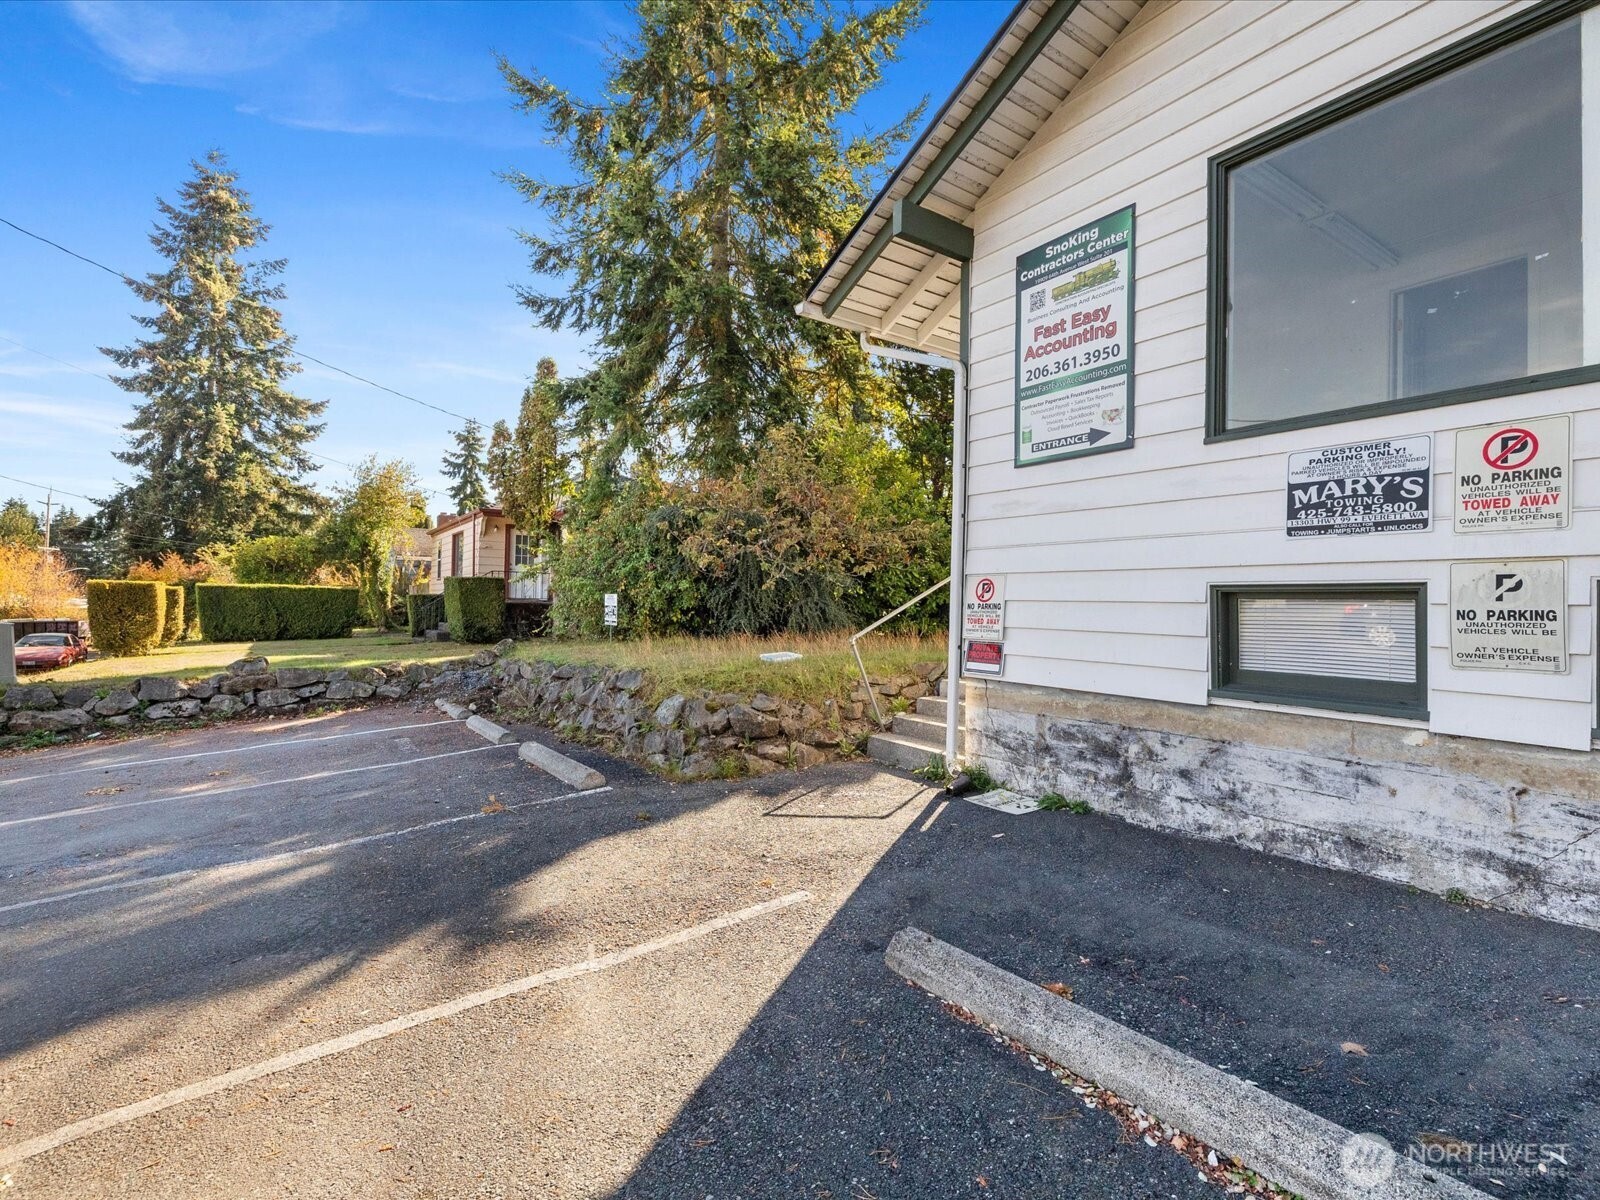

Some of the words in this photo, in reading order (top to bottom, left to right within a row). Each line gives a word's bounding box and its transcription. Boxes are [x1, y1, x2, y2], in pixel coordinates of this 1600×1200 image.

[1045, 227, 1099, 258] SnoKing
[1020, 248, 1085, 282] Contractors
[1087, 229, 1129, 253] Center
[1027, 313, 1049, 325] Business
[1049, 302, 1078, 316] Consulting
[1079, 296, 1090, 305] And
[1091, 285, 1124, 300] Accounting
[1034, 318, 1067, 342] Fast
[1071, 304, 1112, 330] Easy
[1024, 321, 1117, 362] Accounting
[1025, 343, 1120, 382] 206.361.3950
[1020, 363, 1127, 397] www.FastEasyAccounting.com
[1021, 401, 1044, 411] Contractor
[1044, 395, 1070, 406] Paperwork
[1070, 387, 1100, 398] Frustrations
[1100, 381, 1125, 392] Removed
[1030, 406, 1054, 416] Outsourced
[1054, 402, 1070, 411] Payroll
[1074, 398, 1086, 406] Sales
[1095, 391, 1114, 401] Reports
[1041, 410, 1066, 420] Accounting
[1070, 402, 1101, 413] Bookkeeping
[1068, 411, 1095, 420] QuickBooks
[1074, 418, 1094, 428] Services
[1032, 433, 1089, 452] ENTRANCE
[1322, 441, 1392, 457] CUSTOMER
[1302, 460, 1354, 471] UNAUTHORIZED
[1366, 453, 1414, 463] IMPROPERLY
[1308, 452, 1363, 466] PARKING
[1367, 447, 1406, 459] ONLY!
[1318, 465, 1351, 474] VEHICLES
[1381, 455, 1427, 467] IMPOUNDED
[1316, 469, 1347, 478] OWNER'S
[1349, 467, 1365, 475] RISK
[1373, 462, 1407, 472] EXPENSE
[1337, 472, 1361, 480] HOURS
[1461, 474, 1482, 487] NO
[1491, 466, 1562, 484] PARKING
[1292, 476, 1424, 508] MARY'S
[1461, 490, 1511, 500] VEHICLES
[1516, 487, 1542, 496] WILL
[1470, 480, 1551, 493] UNAUTHORIZED
[1297, 501, 1417, 519] 425-743-5800
[1325, 496, 1384, 508] TOWING
[1462, 497, 1511, 511] TOWED
[1520, 493, 1560, 507] AWAY
[1495, 506, 1543, 516] VEHICLE
[1290, 519, 1317, 527] 13303
[1317, 517, 1338, 525] HWY
[1340, 516, 1351, 524] 99
[1408, 511, 1425, 519] WA
[1460, 515, 1508, 525] OWNER'S
[1510, 512, 1563, 521] EXPENSE
[1326, 526, 1376, 535] JUMPSTARTS
[1383, 523, 1424, 532] UNLOCKS
[1456, 609, 1477, 621] NO
[1487, 609, 1558, 622] PARKING
[968, 651, 1001, 660] PROPERTY
[971, 643, 999, 652] PRIVATE
[1492, 647, 1539, 655] VEHICLE
[1456, 653, 1506, 661] OWNER'S
[1508, 654, 1560, 663] EXPENSE
